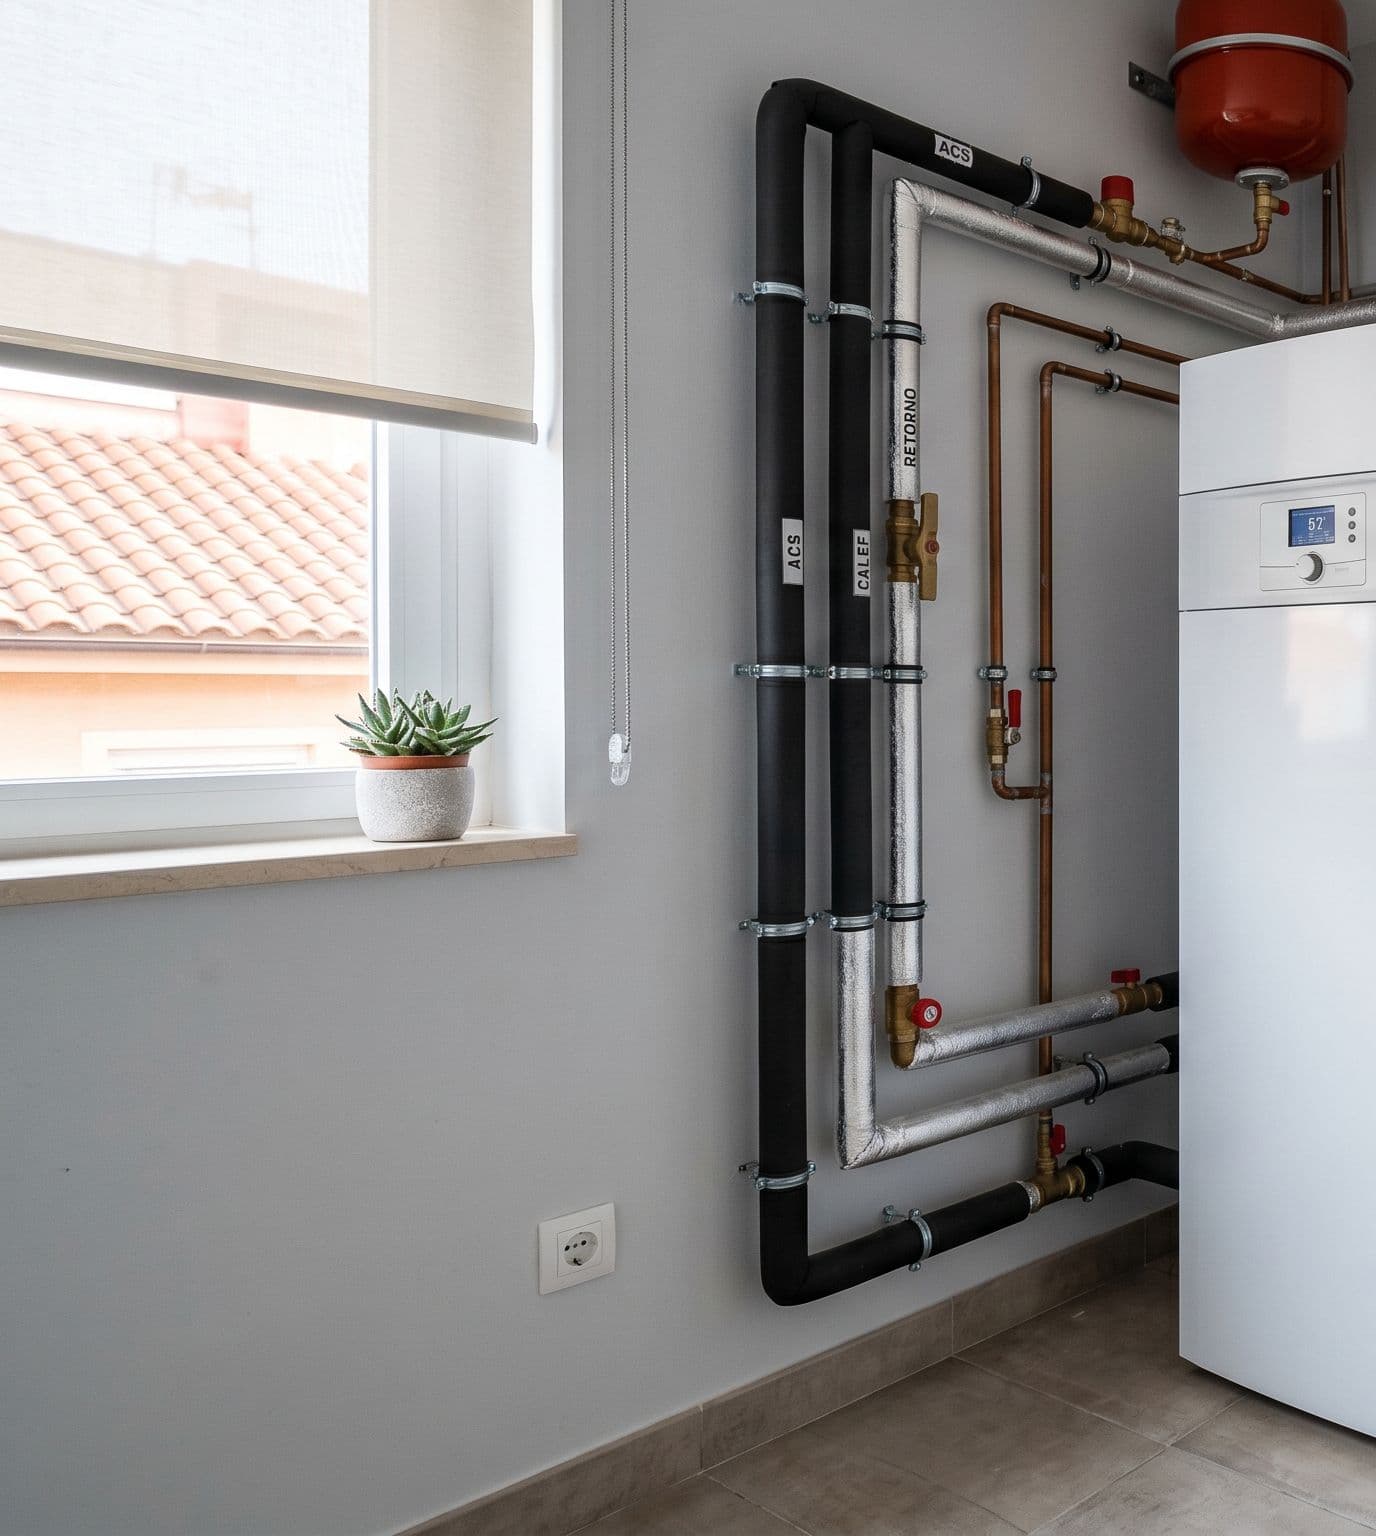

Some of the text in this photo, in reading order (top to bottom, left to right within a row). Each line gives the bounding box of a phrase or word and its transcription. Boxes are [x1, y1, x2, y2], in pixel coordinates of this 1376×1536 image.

[939, 140, 970, 162] ACS
[903, 388, 916, 467] RETORNO
[787, 535, 801, 569] ACS
[857, 536, 870, 590] CALEF
